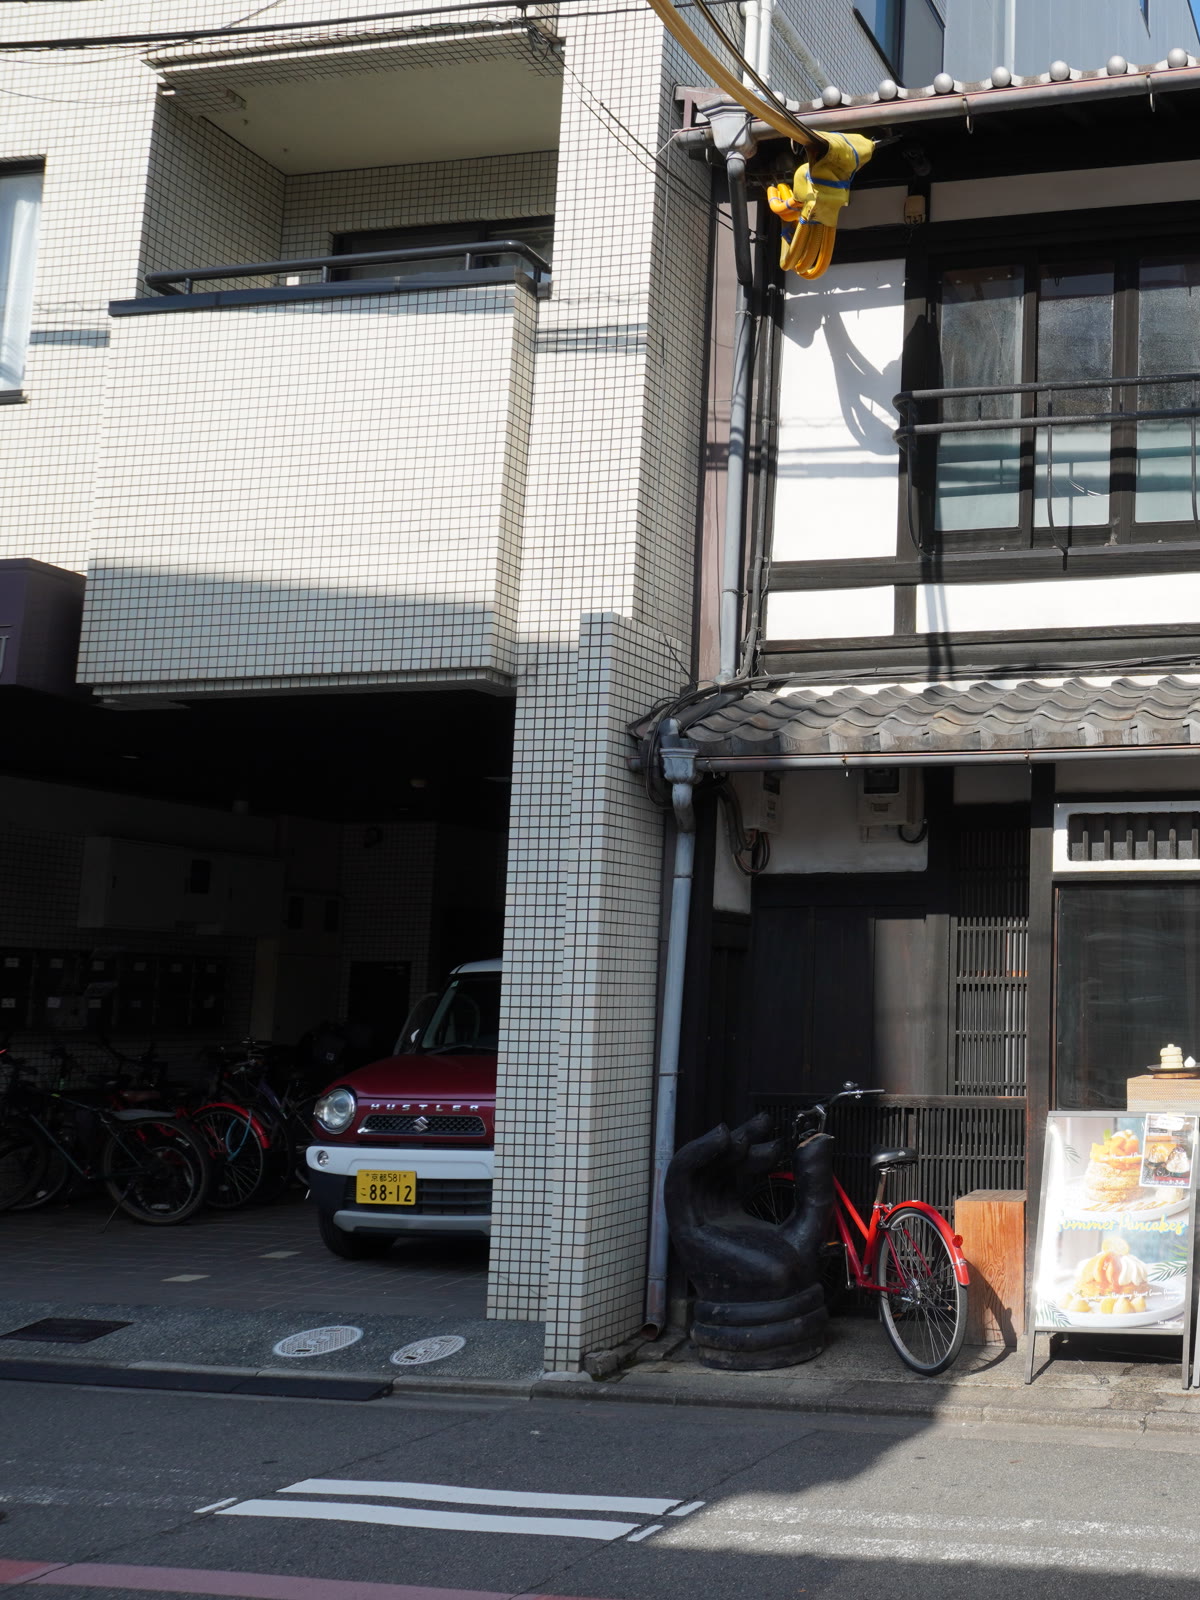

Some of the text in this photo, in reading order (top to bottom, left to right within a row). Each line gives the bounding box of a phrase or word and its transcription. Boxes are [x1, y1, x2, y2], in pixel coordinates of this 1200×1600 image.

[370, 1103, 479, 1112] HUSTLER
[369, 1184, 412, 1202] 88-12
[1118, 1213, 1188, 1236] Pancakes
